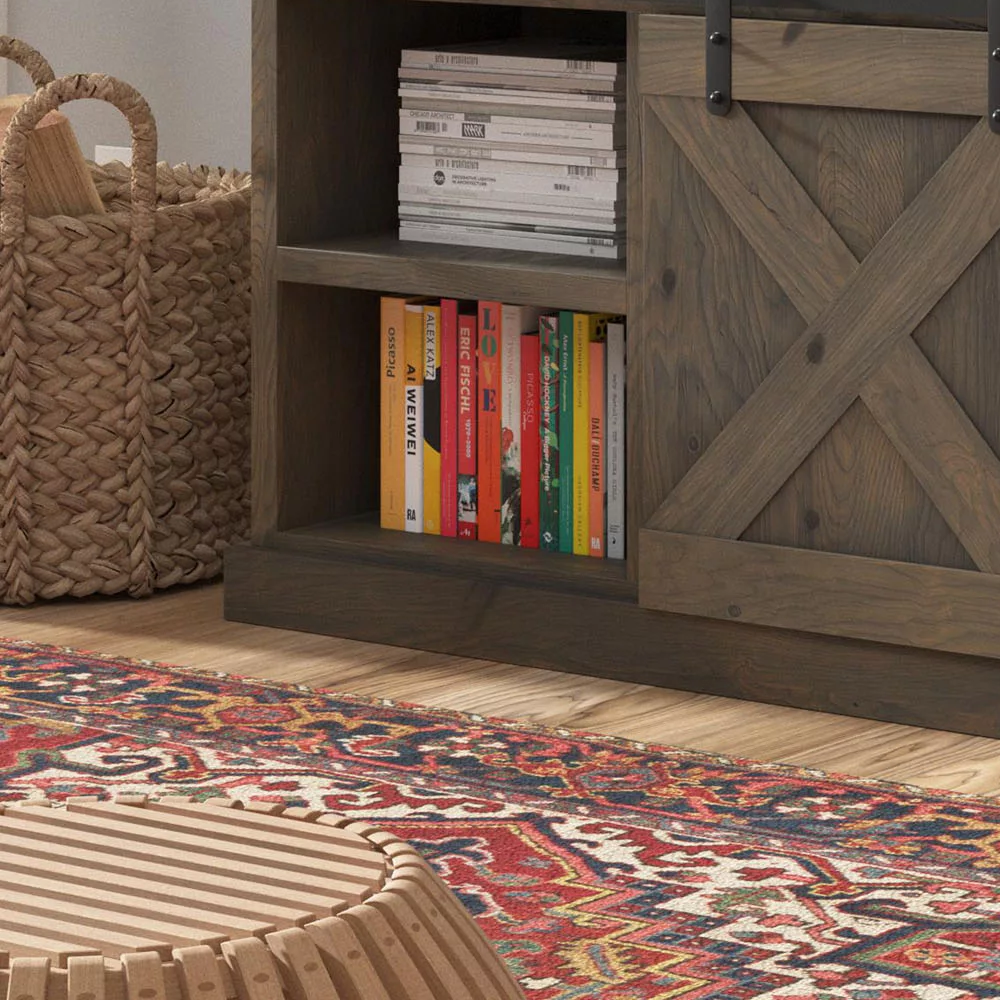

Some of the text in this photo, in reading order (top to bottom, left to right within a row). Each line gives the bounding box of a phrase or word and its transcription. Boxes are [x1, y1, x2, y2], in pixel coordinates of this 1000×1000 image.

[386, 327, 396, 378] Picasso
[426, 313, 435, 378] ALEX KATZ
[460, 327, 470, 360] ERIC
[407, 364, 416, 456] AI WEIWEI
[460, 365, 471, 415] FISCHL
[526, 372, 534, 423] PICASSO
